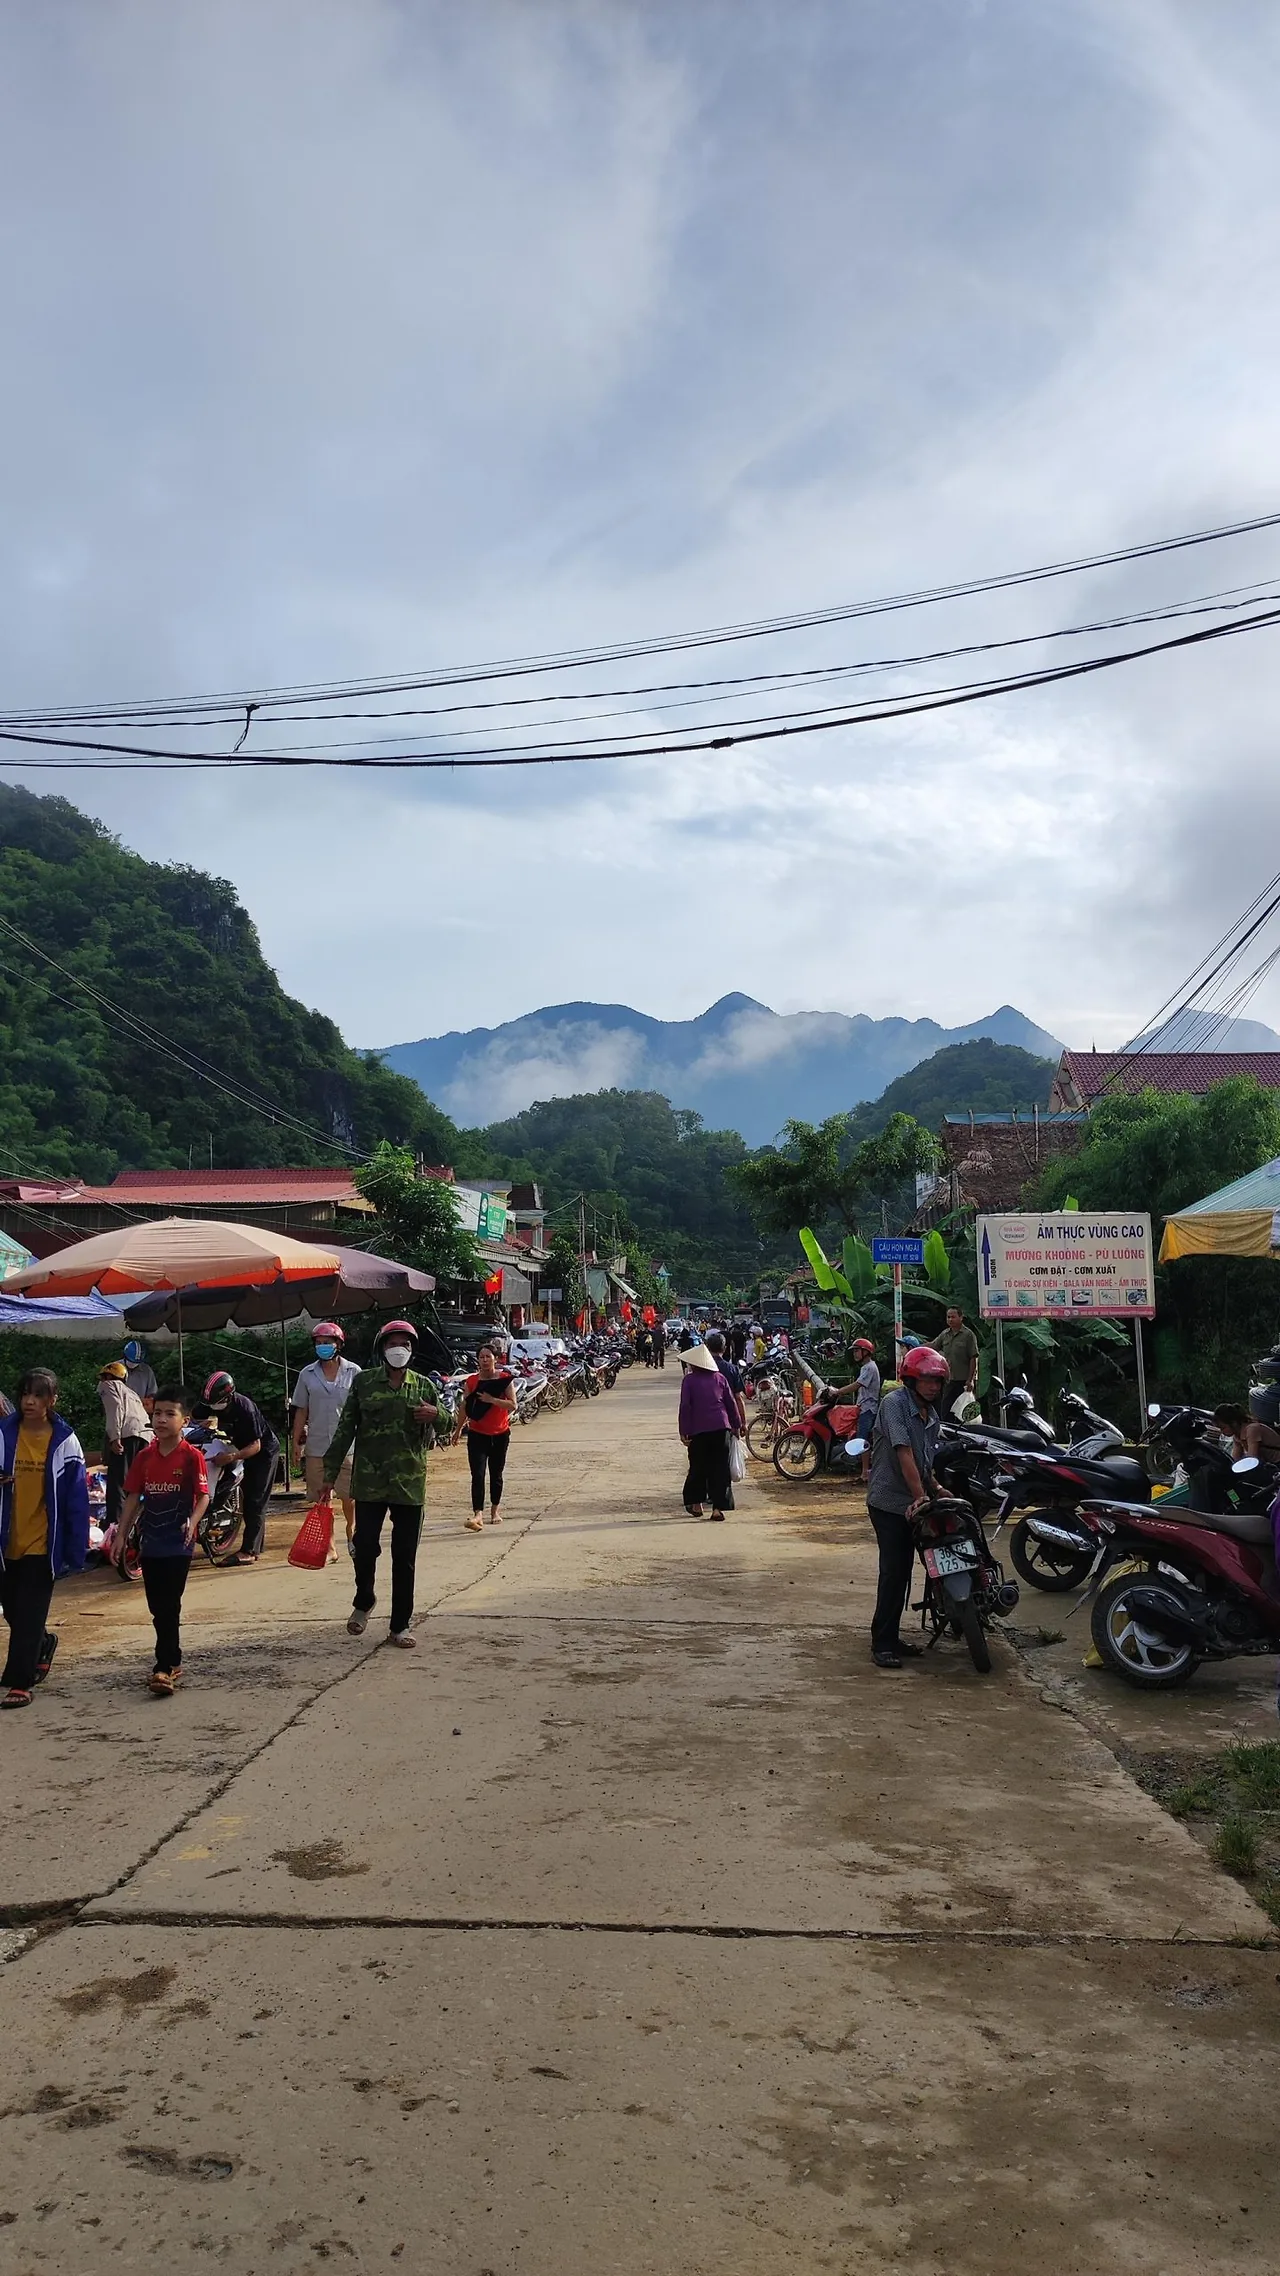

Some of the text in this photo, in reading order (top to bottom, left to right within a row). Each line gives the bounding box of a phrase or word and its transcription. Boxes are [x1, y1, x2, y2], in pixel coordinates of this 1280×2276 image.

[1037, 1218, 1144, 1243] ẨM THỰC VÙNG CAO
[1005, 1248, 1042, 1261] MƯỜNG
[1095, 1247, 1109, 1260] PÙ
[1029, 1266, 1048, 1275] CƠM
[1074, 1265, 1093, 1275] CƠM
[1095, 1263, 1116, 1275] XUẤT
[144, 1481, 181, 1492] Rakuten
